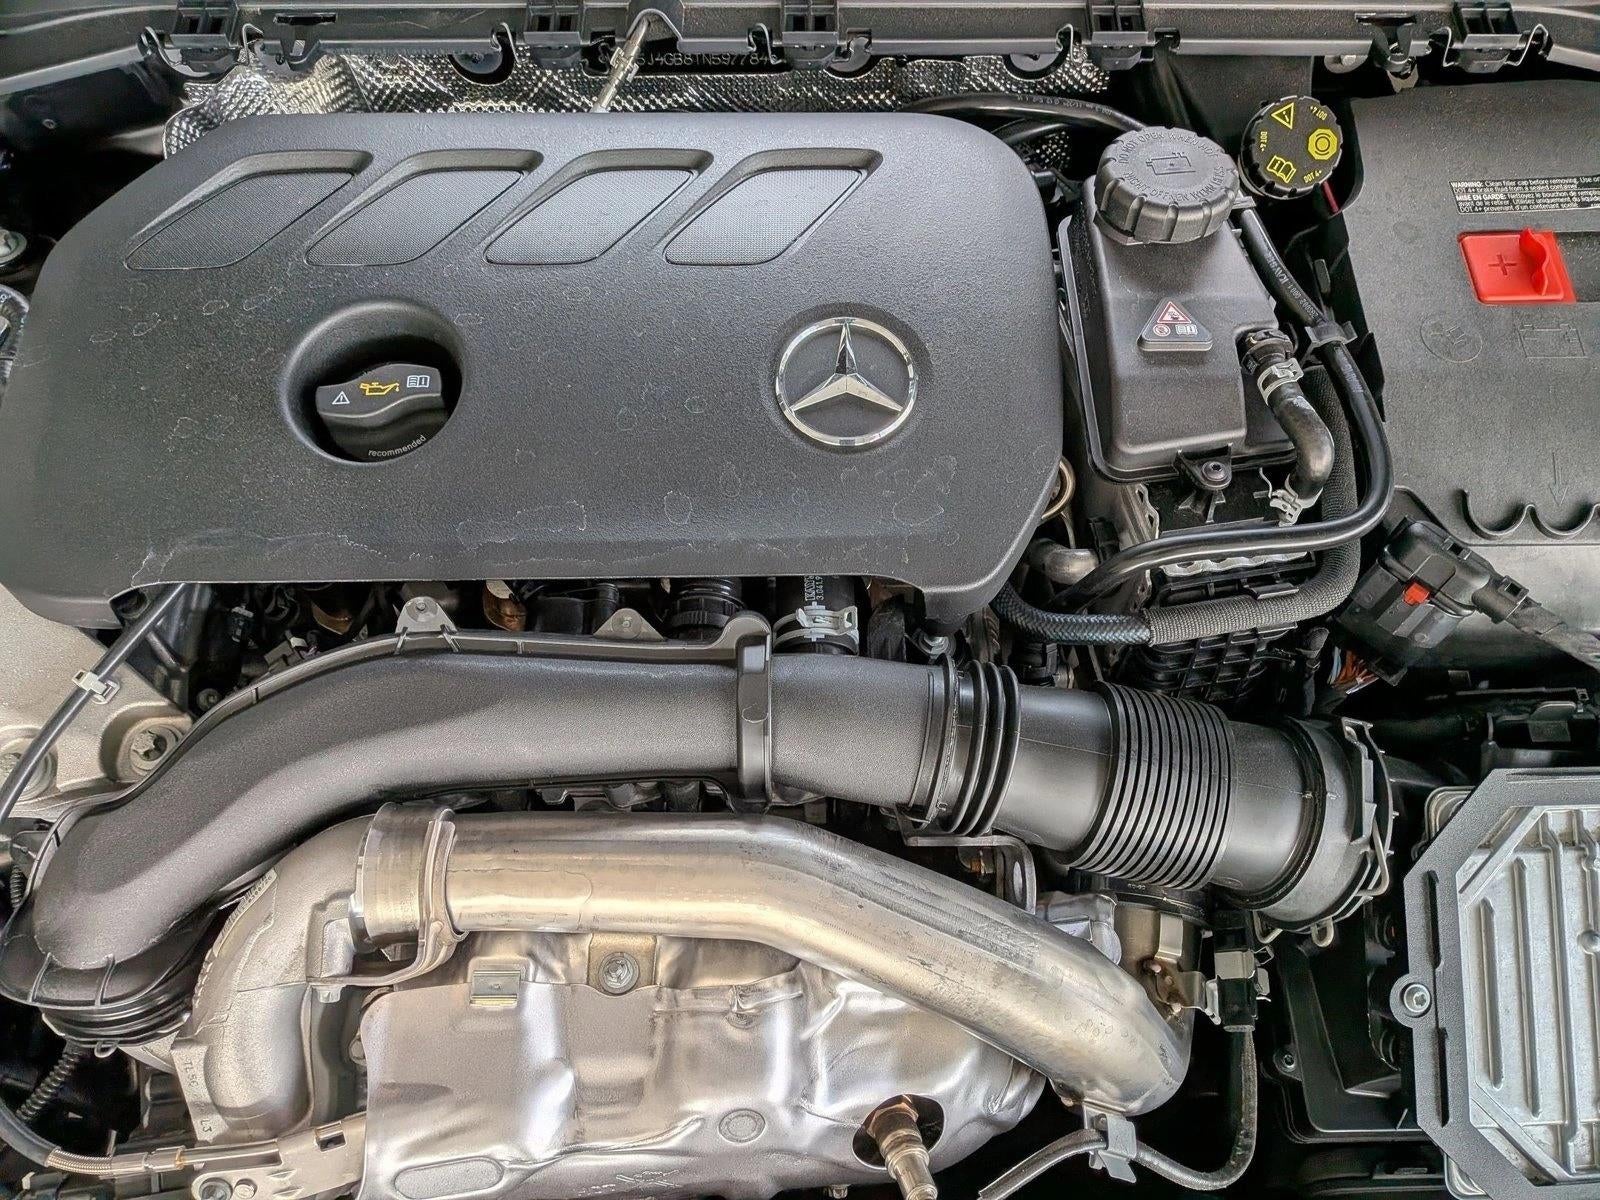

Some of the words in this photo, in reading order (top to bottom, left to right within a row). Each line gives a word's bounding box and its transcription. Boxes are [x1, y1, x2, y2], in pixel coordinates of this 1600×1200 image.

[1316, 110, 1328, 121] DOT
[1260, 131, 1268, 143] DOT
[1303, 172, 1316, 183] DOT
[1450, 180, 1484, 188] WARNING:
[1455, 193, 1472, 201] MISE
[1472, 193, 1483, 201] EN
[1482, 192, 1507, 201] GARDE:
[368, 434, 427, 457] recommended
